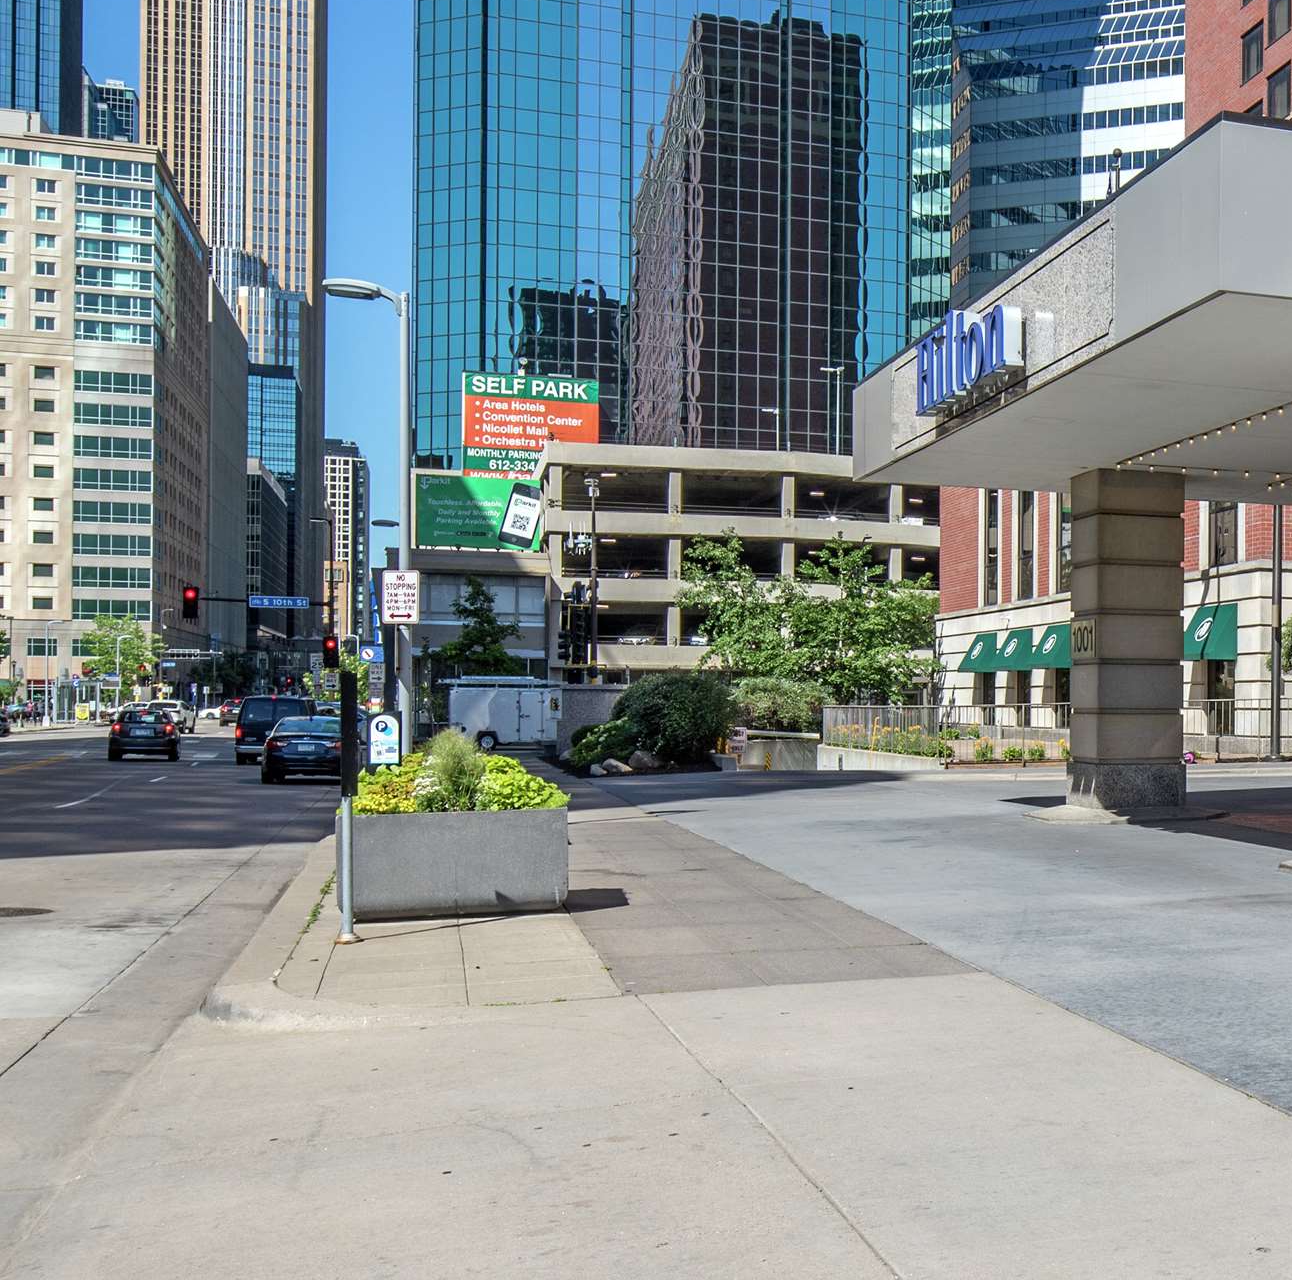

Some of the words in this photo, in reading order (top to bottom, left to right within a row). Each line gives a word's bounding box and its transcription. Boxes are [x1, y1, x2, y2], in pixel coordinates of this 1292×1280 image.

[915, 304, 1007, 417] Hilton
[471, 375, 526, 395] SELF
[531, 380, 588, 400] PARK
[482, 399, 509, 410] Area
[511, 401, 546, 412] Hotels
[482, 411, 544, 424] Convention
[546, 415, 583, 426] Center
[482, 423, 523, 434] Nicollet
[526, 426, 548, 436] Mall
[482, 435, 537, 447] Orchestra
[467, 448, 506, 458] MONTHLY
[508, 450, 545, 460] PARKING
[489, 459, 536, 471] 612-334
[385, 583, 416, 591] STOPPING
[1073, 625, 1093, 653] 1001
